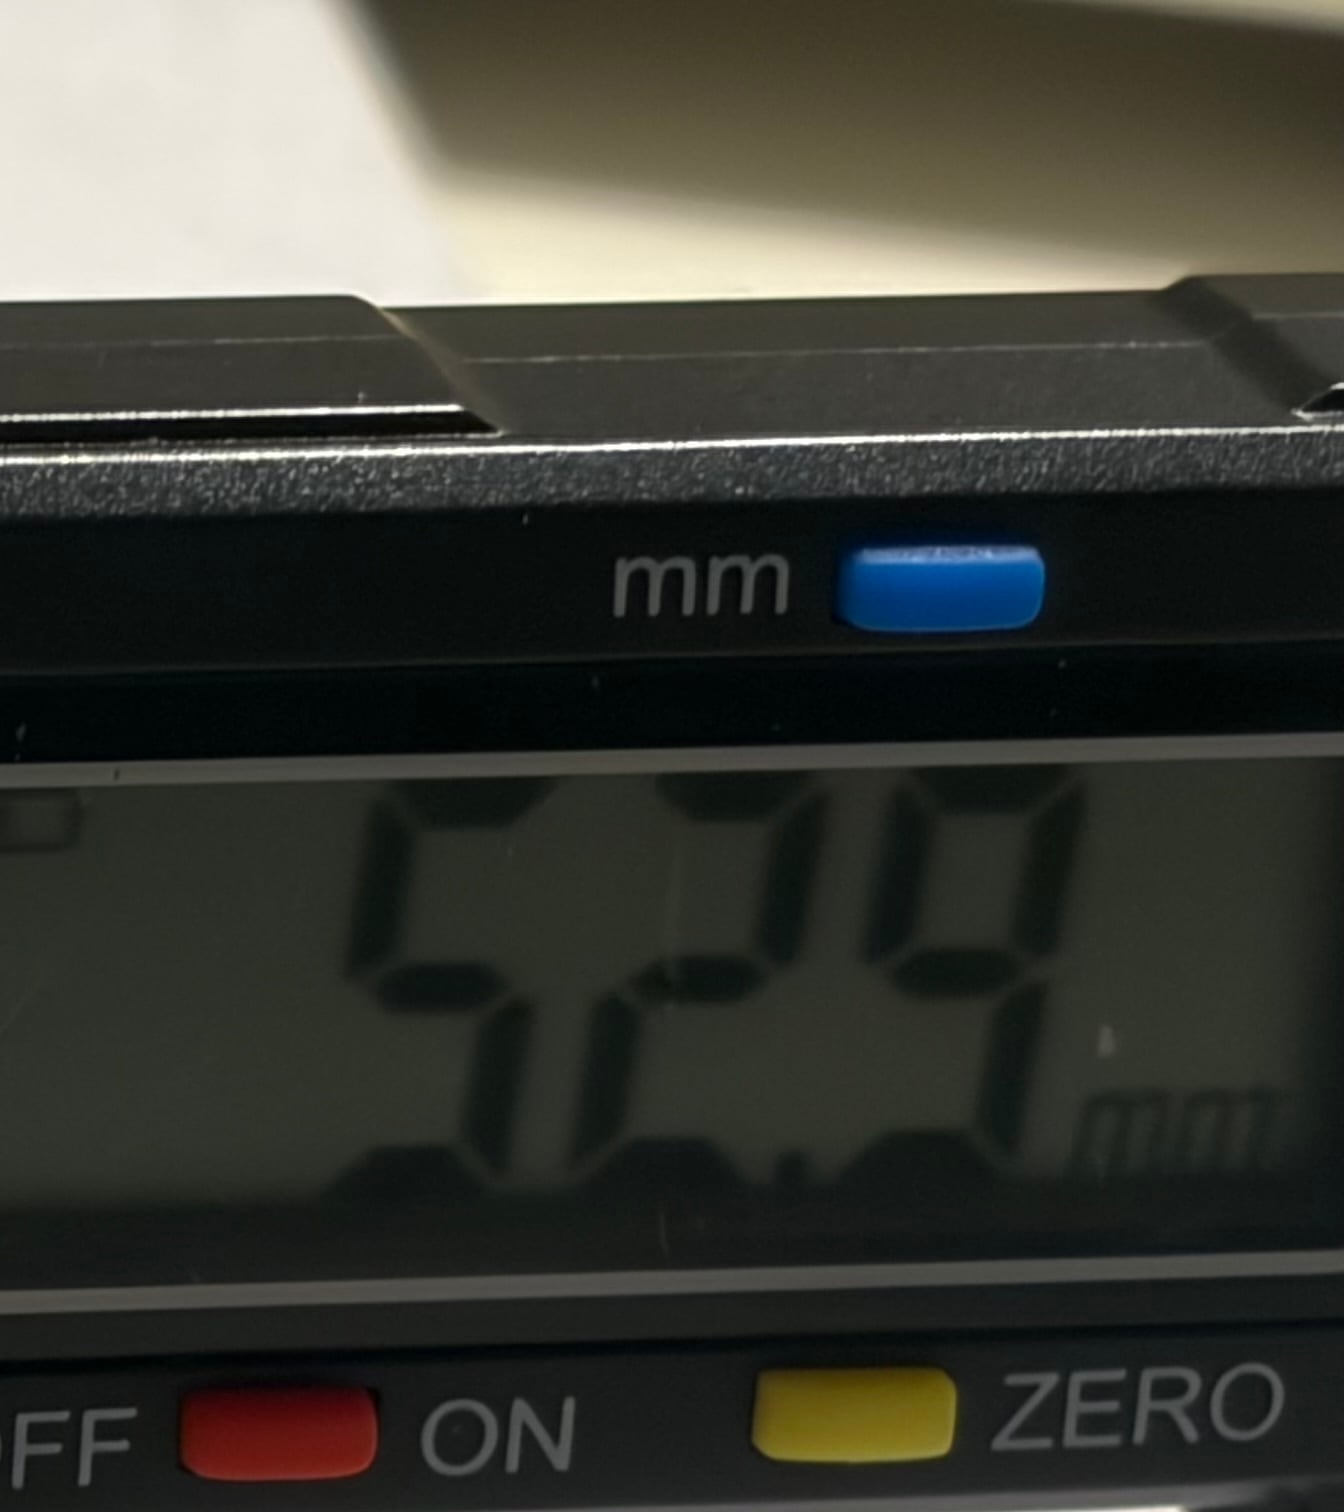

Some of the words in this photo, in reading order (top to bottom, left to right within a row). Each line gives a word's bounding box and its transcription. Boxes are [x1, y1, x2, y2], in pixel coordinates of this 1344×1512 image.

[613, 552, 789, 618] mm
[326, 766, 1085, 1192] 52.9
[1070, 1084, 1297, 1188] mm
[421, 1398, 576, 1475] ON
[992, 1362, 1286, 1453] ZERO
